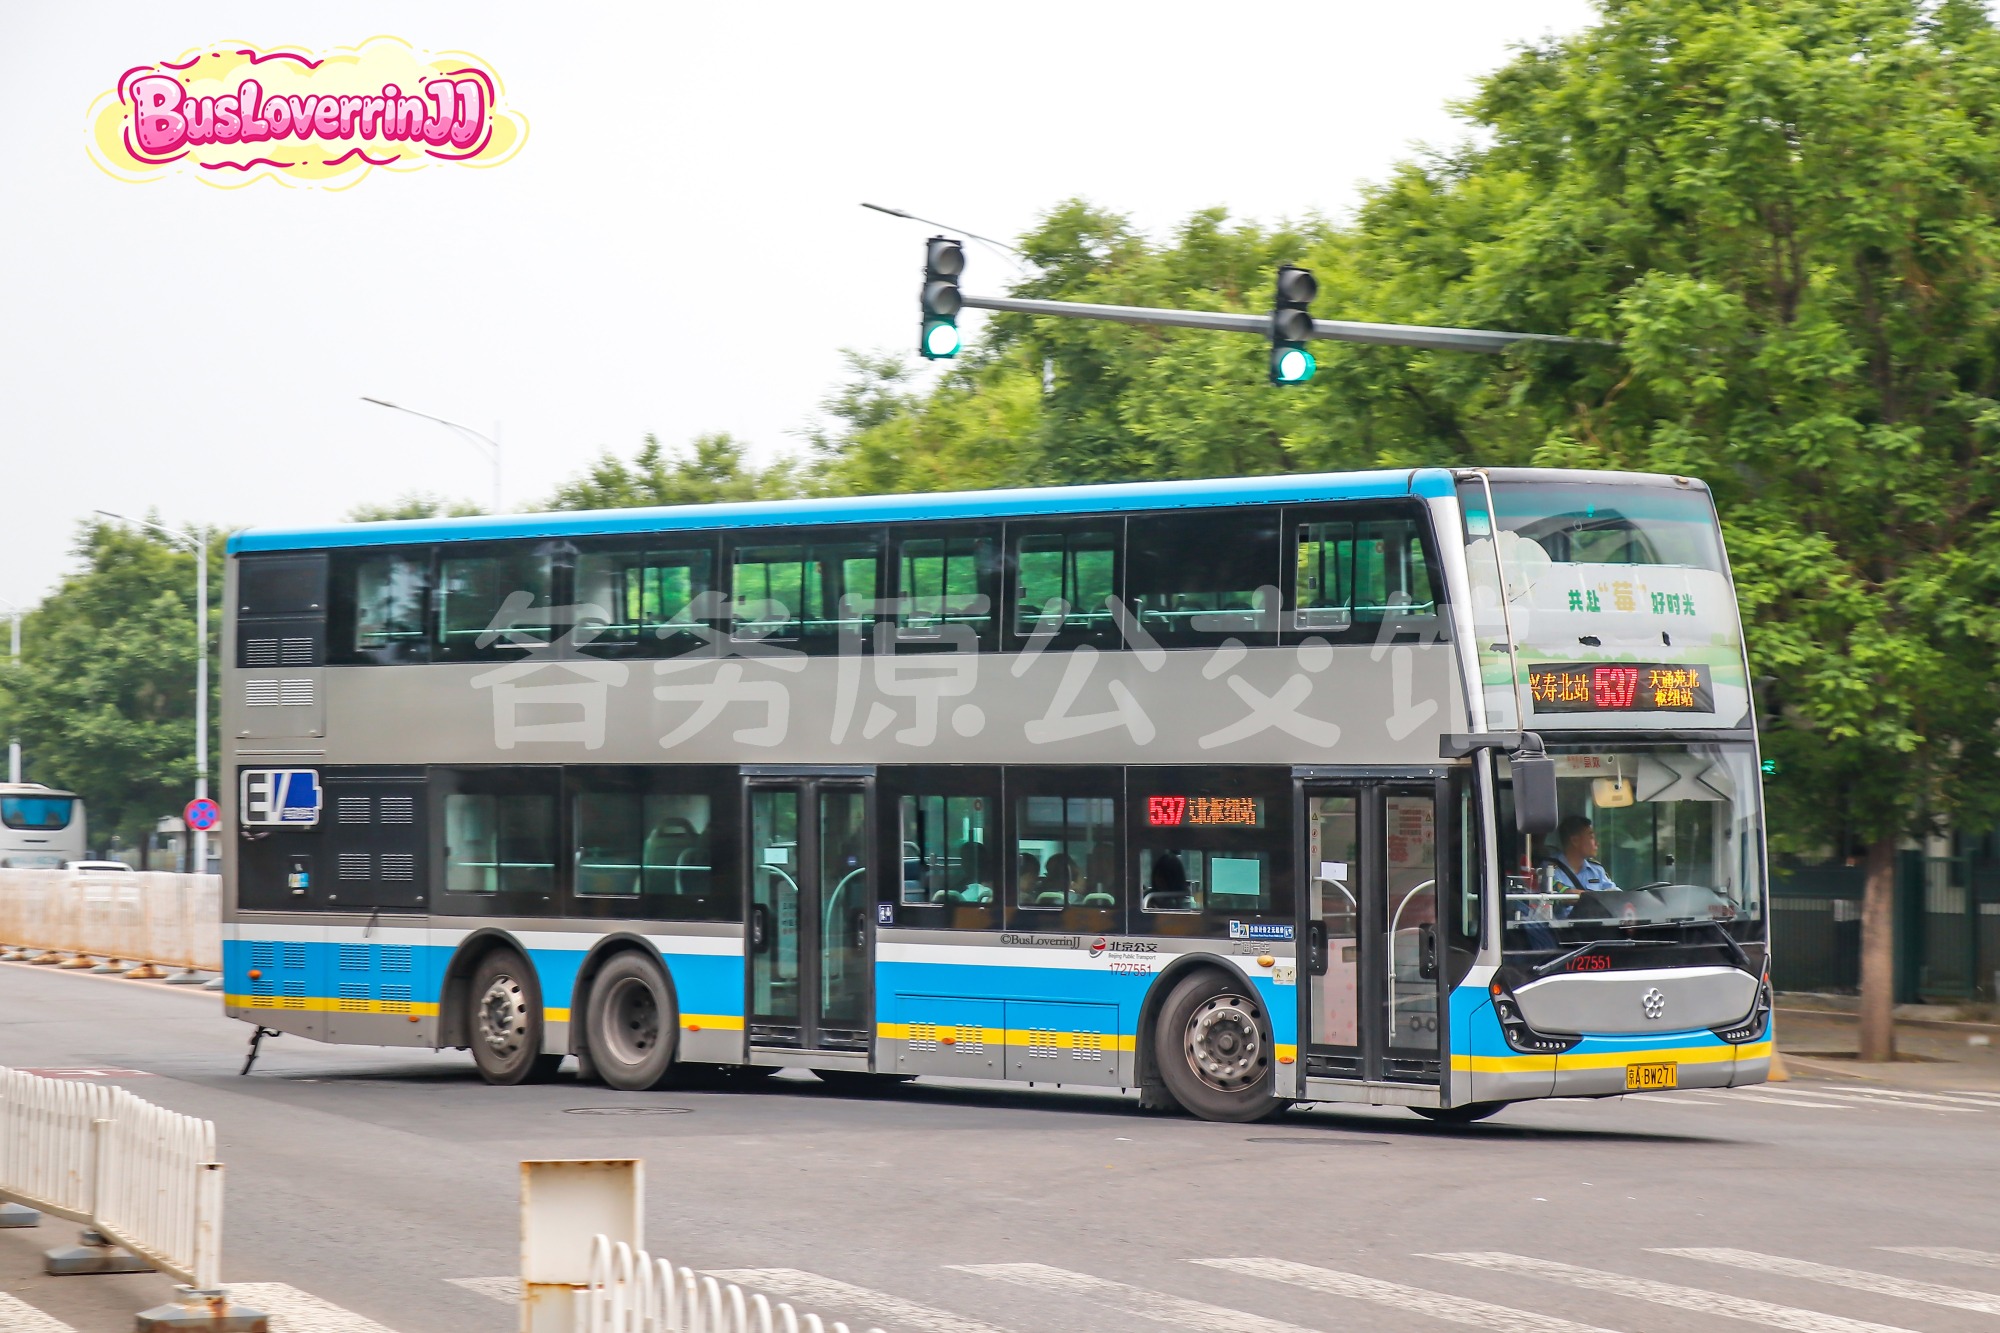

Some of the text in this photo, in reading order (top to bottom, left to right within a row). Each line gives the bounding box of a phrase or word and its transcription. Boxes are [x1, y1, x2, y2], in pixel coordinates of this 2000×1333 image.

[1529, 672, 1590, 703] 兴寿北站
[1594, 667, 1640, 708] 537
[1647, 668, 1700, 690] 天通苑北
[1654, 687, 1694, 708] 枢纽站
[1148, 796, 1185, 825] 537
[1108, 952, 1122, 960] Beijing
[1110, 941, 1158, 952] 北京公交
[1109, 962, 1152, 977] 1727551
